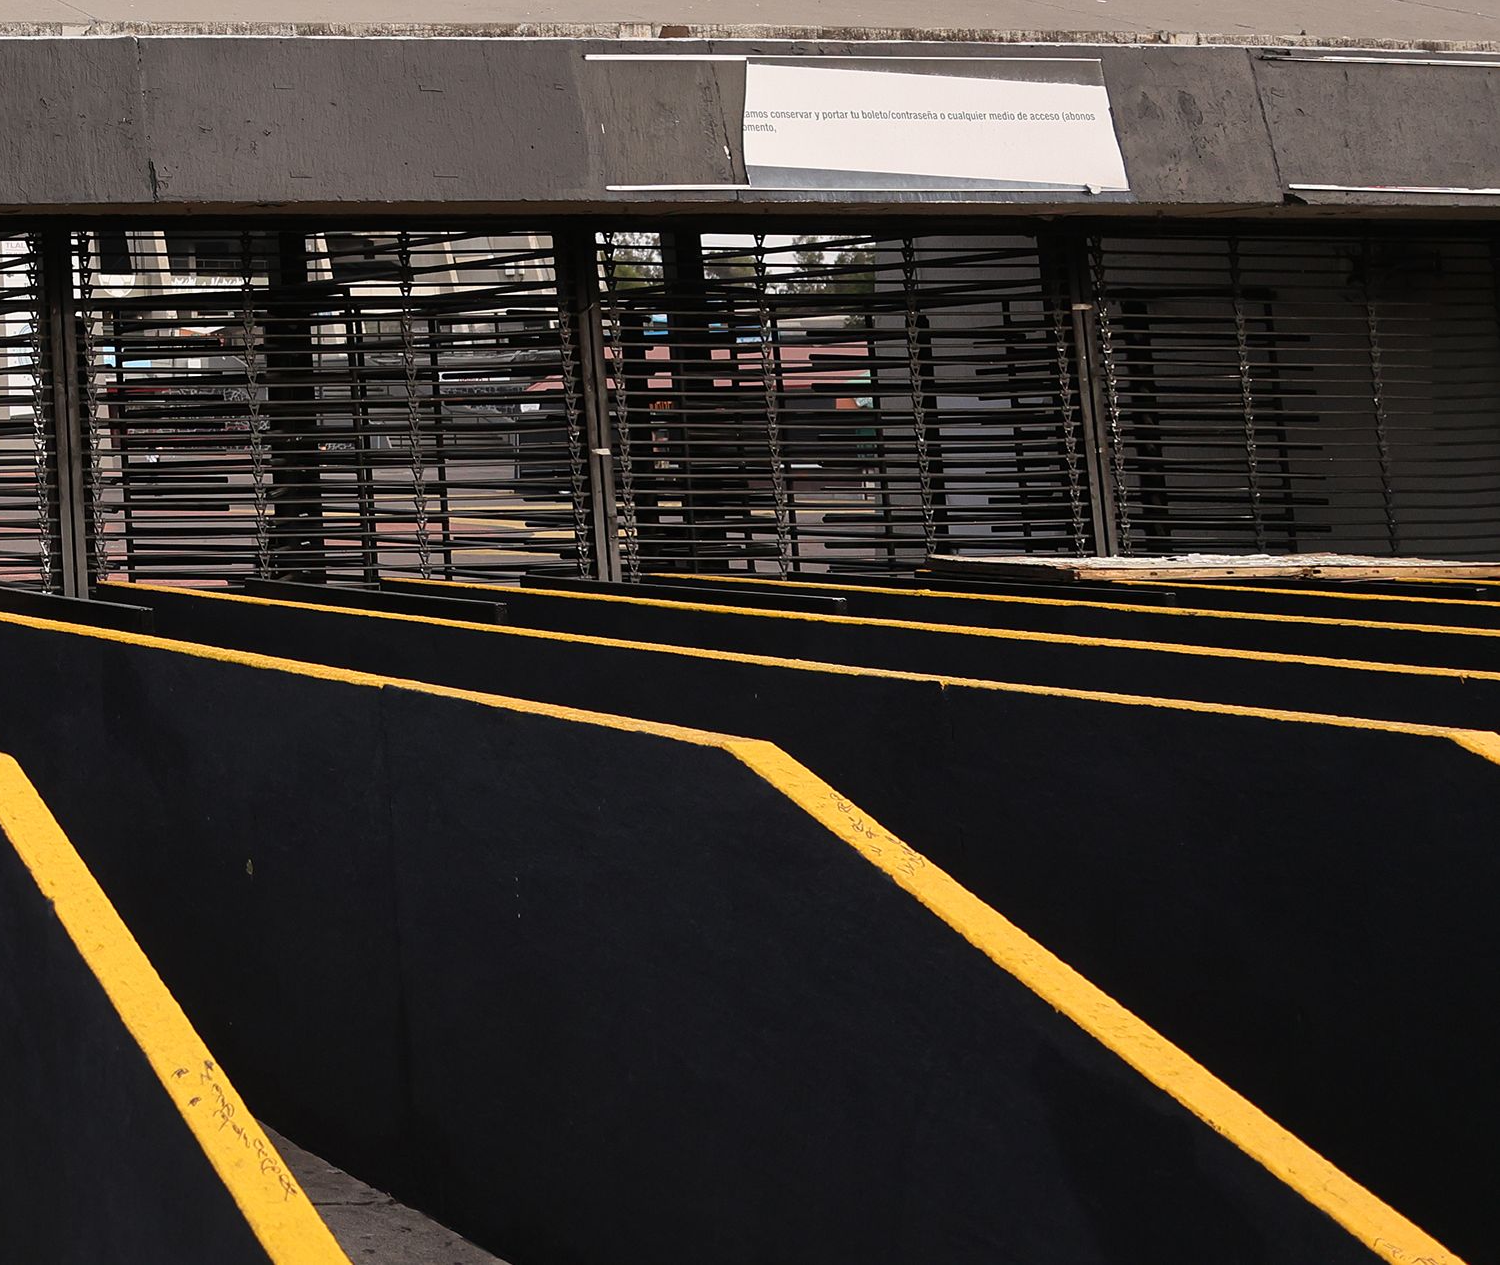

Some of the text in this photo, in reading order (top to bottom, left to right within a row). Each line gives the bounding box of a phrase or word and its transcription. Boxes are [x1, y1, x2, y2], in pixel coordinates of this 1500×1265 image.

[743, 111, 769, 119] amos
[821, 110, 849, 120] portar
[860, 110, 939, 120] boleto/contraseña
[947, 111, 986, 123] cualquier
[989, 112, 1015, 122] medio
[1030, 112, 1060, 122] acceso
[1061, 112, 1096, 122] (abonos
